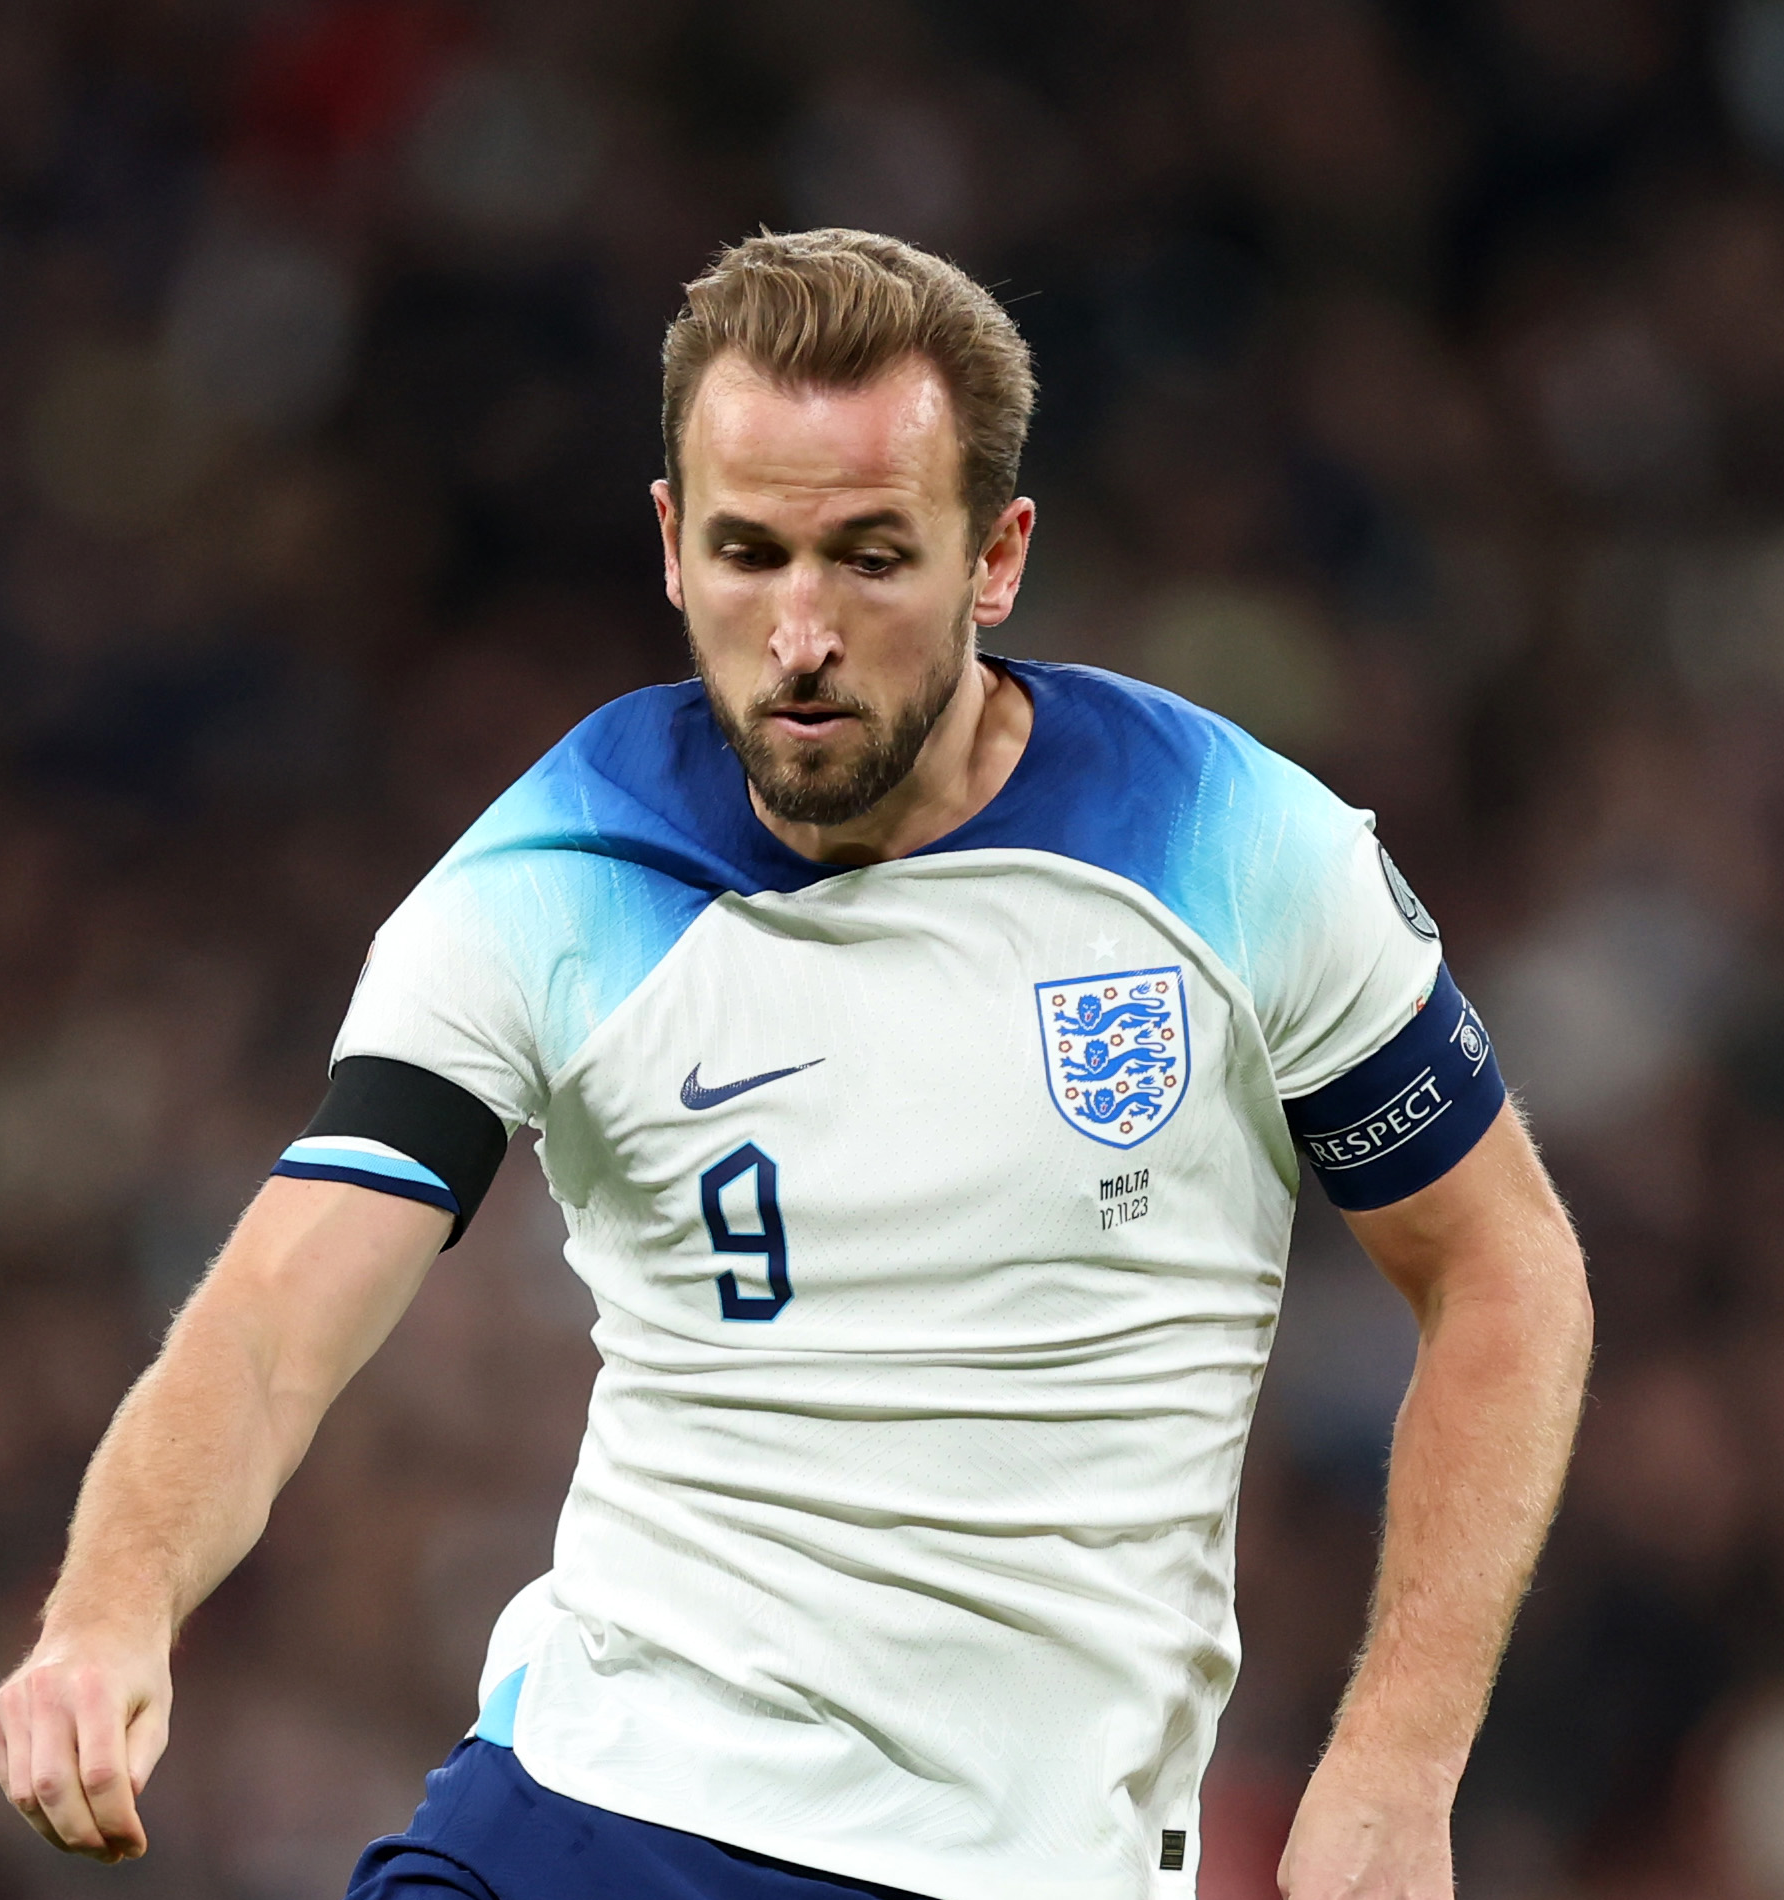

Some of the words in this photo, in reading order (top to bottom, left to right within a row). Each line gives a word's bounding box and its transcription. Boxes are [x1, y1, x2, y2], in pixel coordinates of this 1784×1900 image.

[1310, 1076, 1441, 1162] RESPECT
[1100, 1168, 1149, 1201] MALTA
[1100, 1196, 1148, 1230] 17.11.23
[699, 1139, 794, 1324] 9
